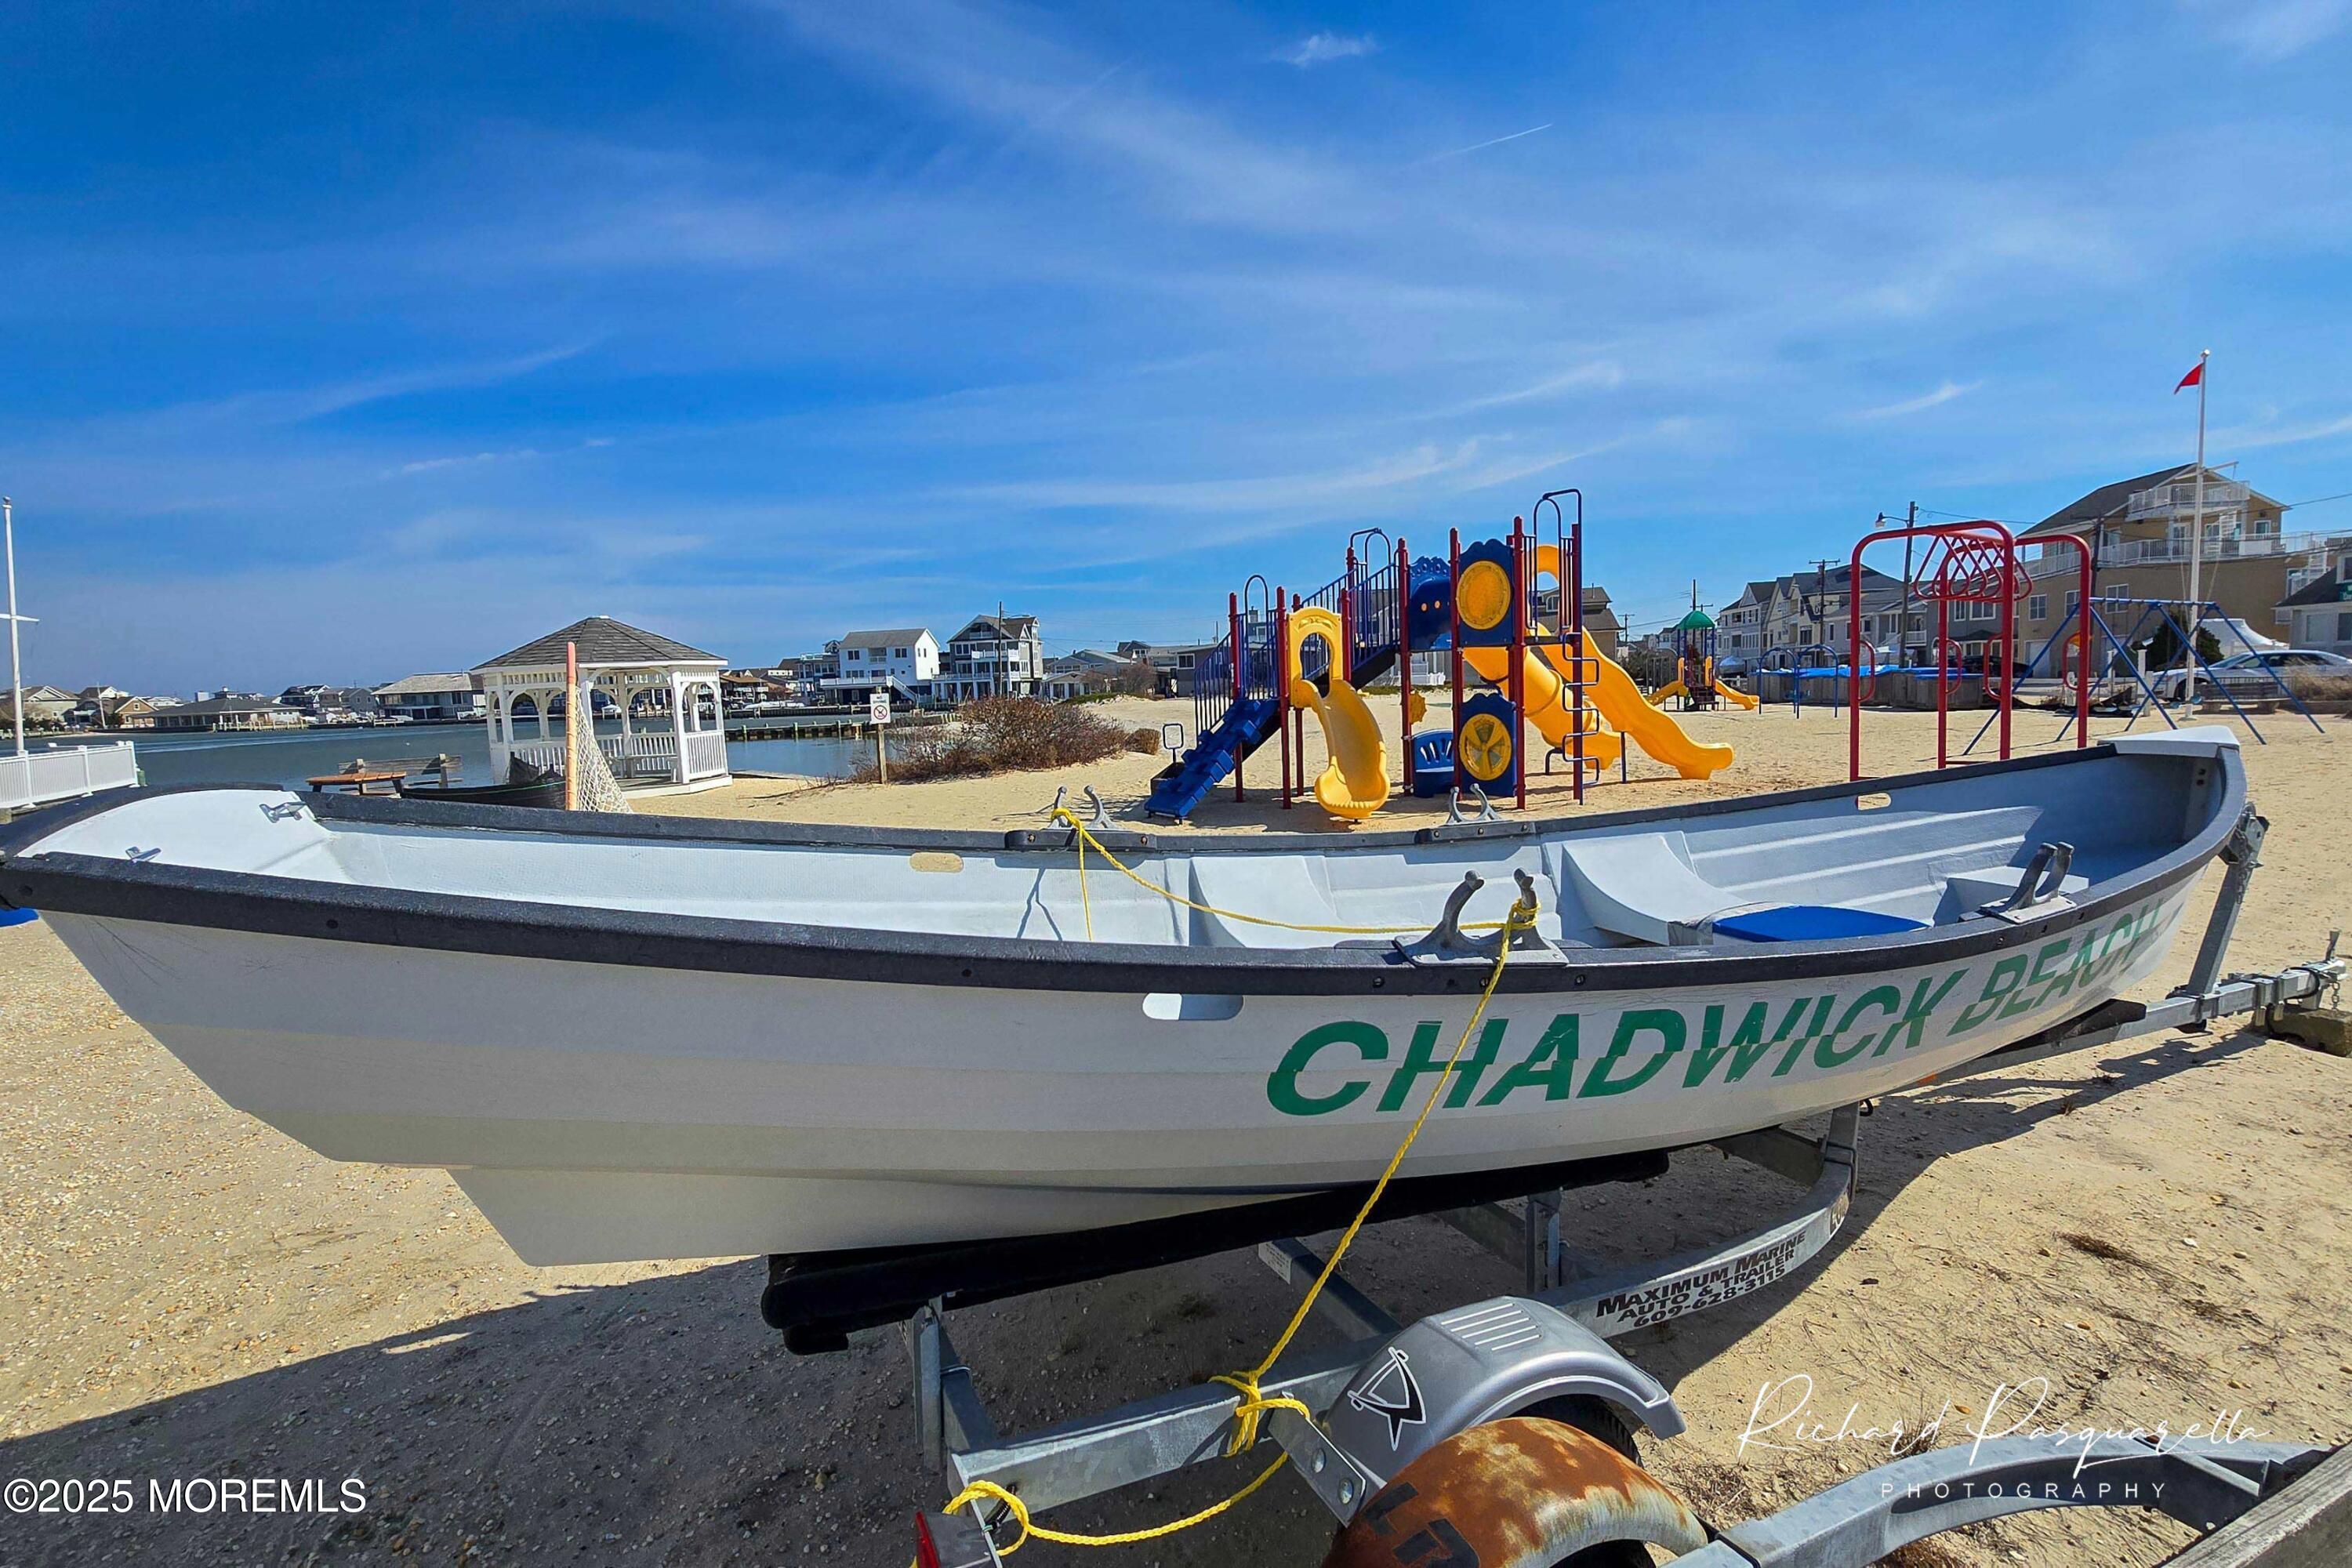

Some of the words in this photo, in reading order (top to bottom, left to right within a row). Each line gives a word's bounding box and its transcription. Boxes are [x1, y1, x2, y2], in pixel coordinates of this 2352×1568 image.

[1267, 967, 1971, 1117] CHADWICK
[1947, 898, 2165, 1036] BEACH
[1596, 1267, 1729, 1318] MAXIMUM
[1735, 1230, 1806, 1273] MARINE
[1617, 1293, 1690, 1323] AUTO
[1698, 1285, 1714, 1298] &
[1721, 1249, 1795, 1289] TRAILER
[1633, 1265, 1786, 1328] 609-628-3115
